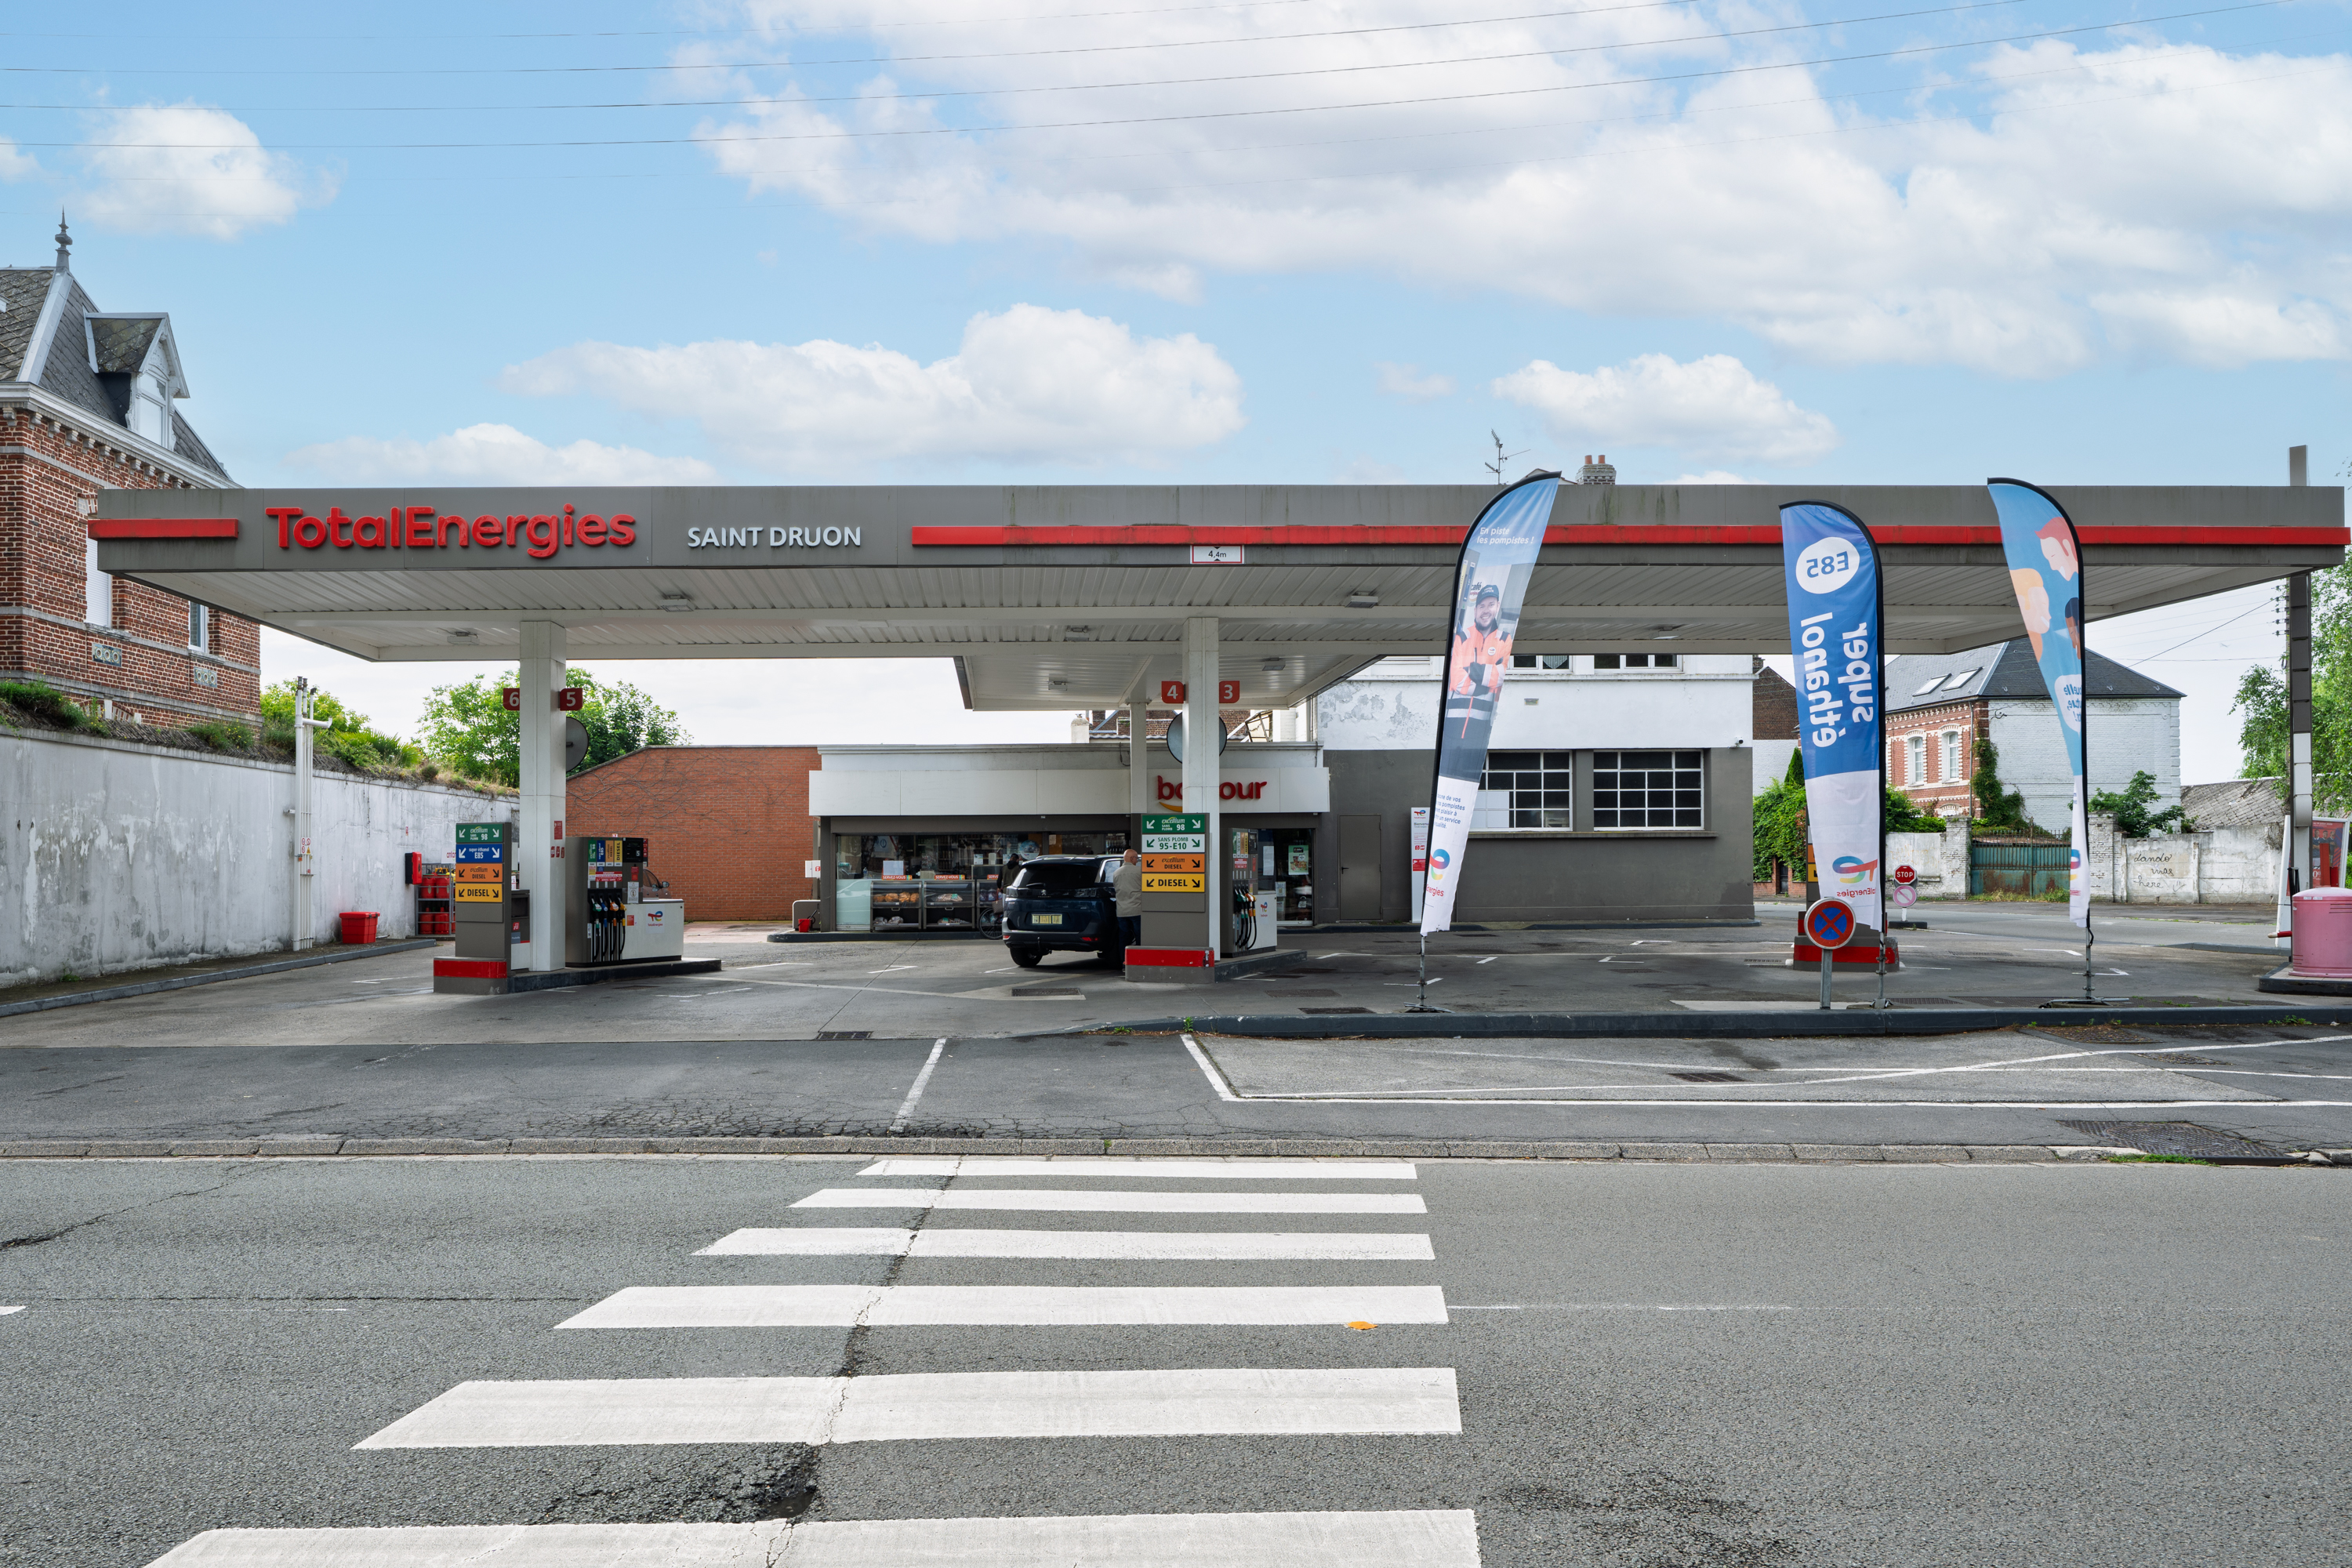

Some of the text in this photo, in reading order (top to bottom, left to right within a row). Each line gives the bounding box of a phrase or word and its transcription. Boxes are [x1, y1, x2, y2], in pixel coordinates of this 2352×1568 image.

[265, 503, 636, 559] TotalEnergies
[688, 526, 861, 547] SAINT DRUON
[1490, 526, 1510, 535] piste
[1476, 535, 1488, 544] les
[1489, 536, 1529, 545] pompistes
[1208, 550, 1227, 559] 4,4m
[1167, 684, 1178, 699] 4
[1223, 684, 1233, 699] 3
[509, 691, 520, 706] 6
[566, 691, 576, 706] 5
[1157, 775, 1267, 800] bour
[1442, 802, 1465, 811] pompistes
[2151, 868, 2174, 877] was
[2132, 875, 2164, 887] here
[467, 888, 489, 897] DIESEL
